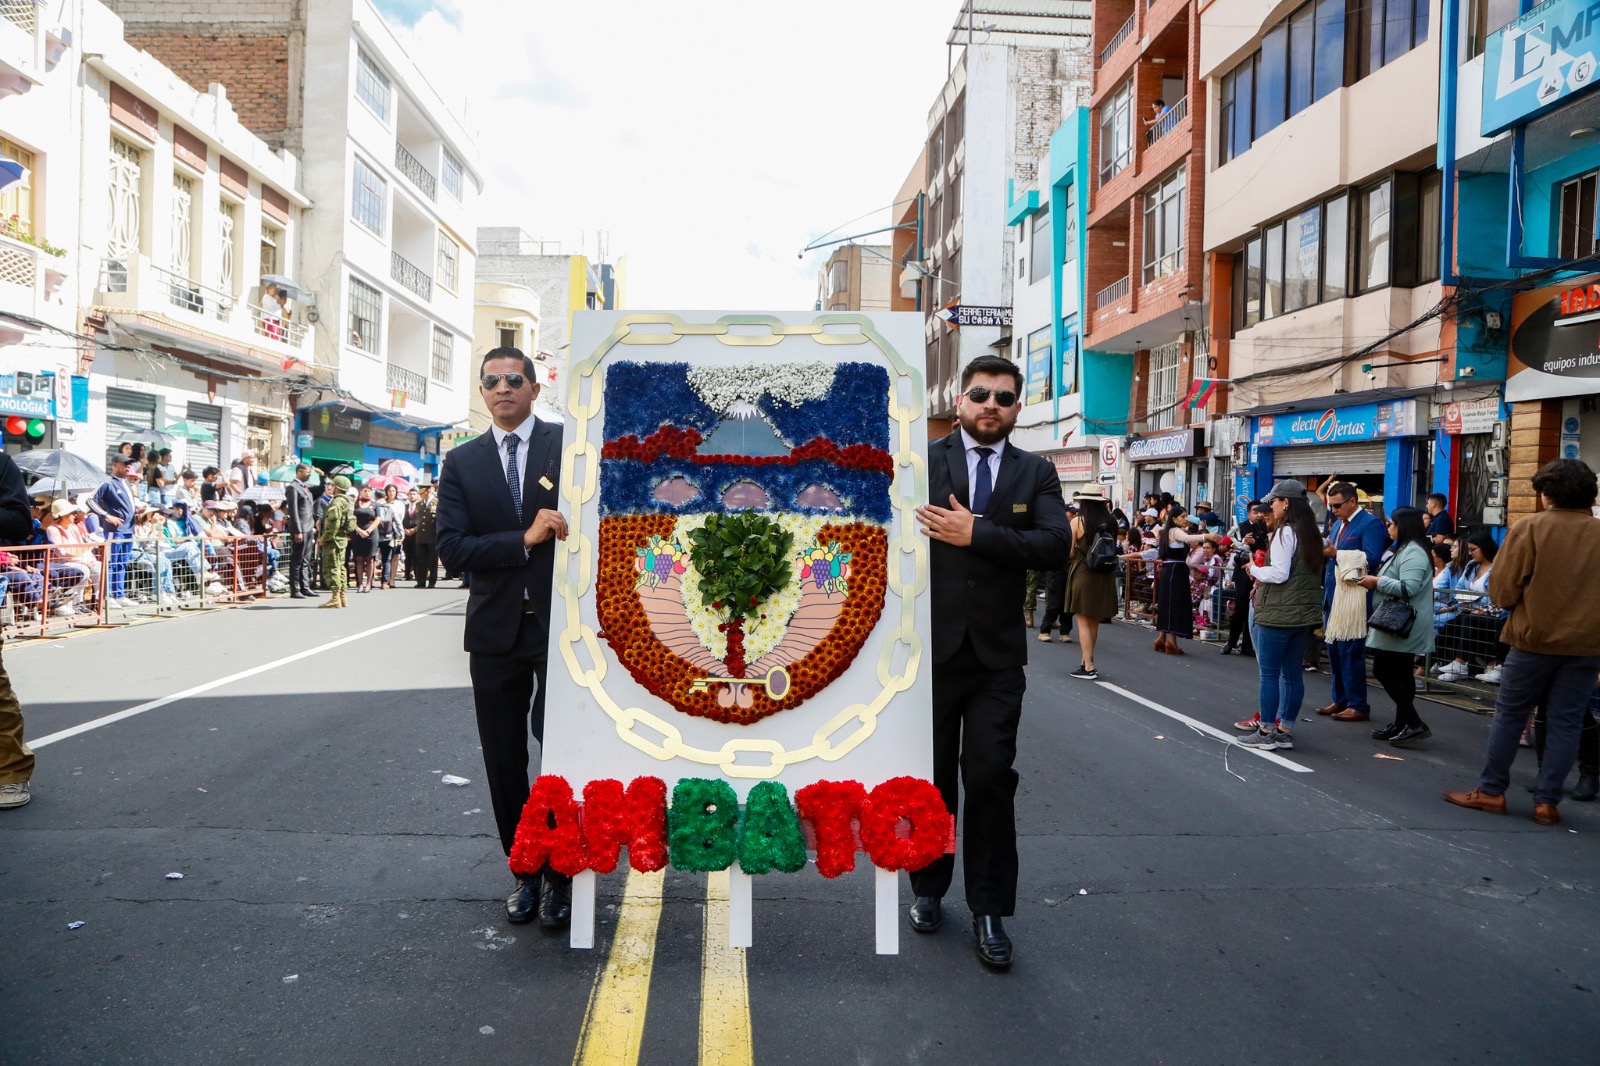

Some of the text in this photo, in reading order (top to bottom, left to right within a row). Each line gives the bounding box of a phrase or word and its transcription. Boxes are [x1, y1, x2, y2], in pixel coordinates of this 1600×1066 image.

[958, 307, 1001, 317] FERRETERIA
[958, 316, 970, 324] SU
[971, 316, 994, 325] CASA
[1543, 357, 1577, 373] equipos
[0, 397, 49, 414] NOLOGIAS
[1462, 399, 1498, 411] OBSTETRIZ
[1291, 408, 1366, 441] electrOfertas
[1129, 433, 1187, 457] COMPUTRON
[508, 774, 951, 879] AMBATO
